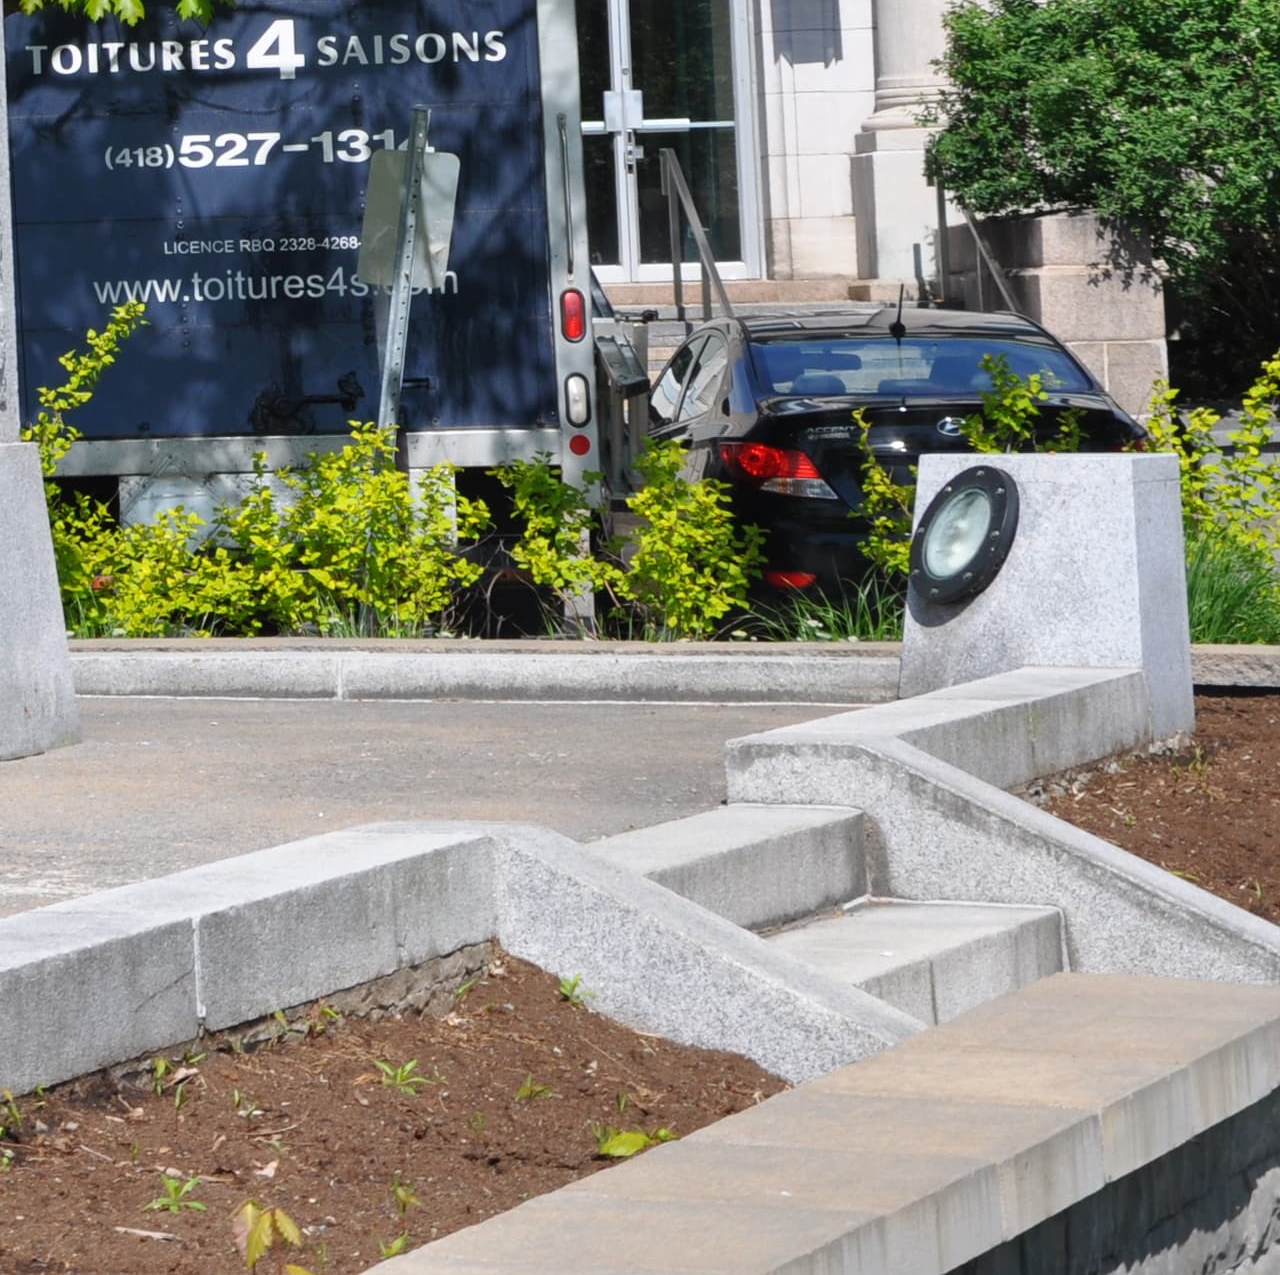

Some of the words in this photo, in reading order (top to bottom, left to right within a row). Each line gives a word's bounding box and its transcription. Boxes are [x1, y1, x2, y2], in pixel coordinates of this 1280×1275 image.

[24, 38, 237, 75] TOITURES
[246, 18, 306, 80] 4
[316, 30, 507, 66] SAISONS
[164, 240, 234, 255] LICENCE
[239, 238, 275, 253] RBQ
